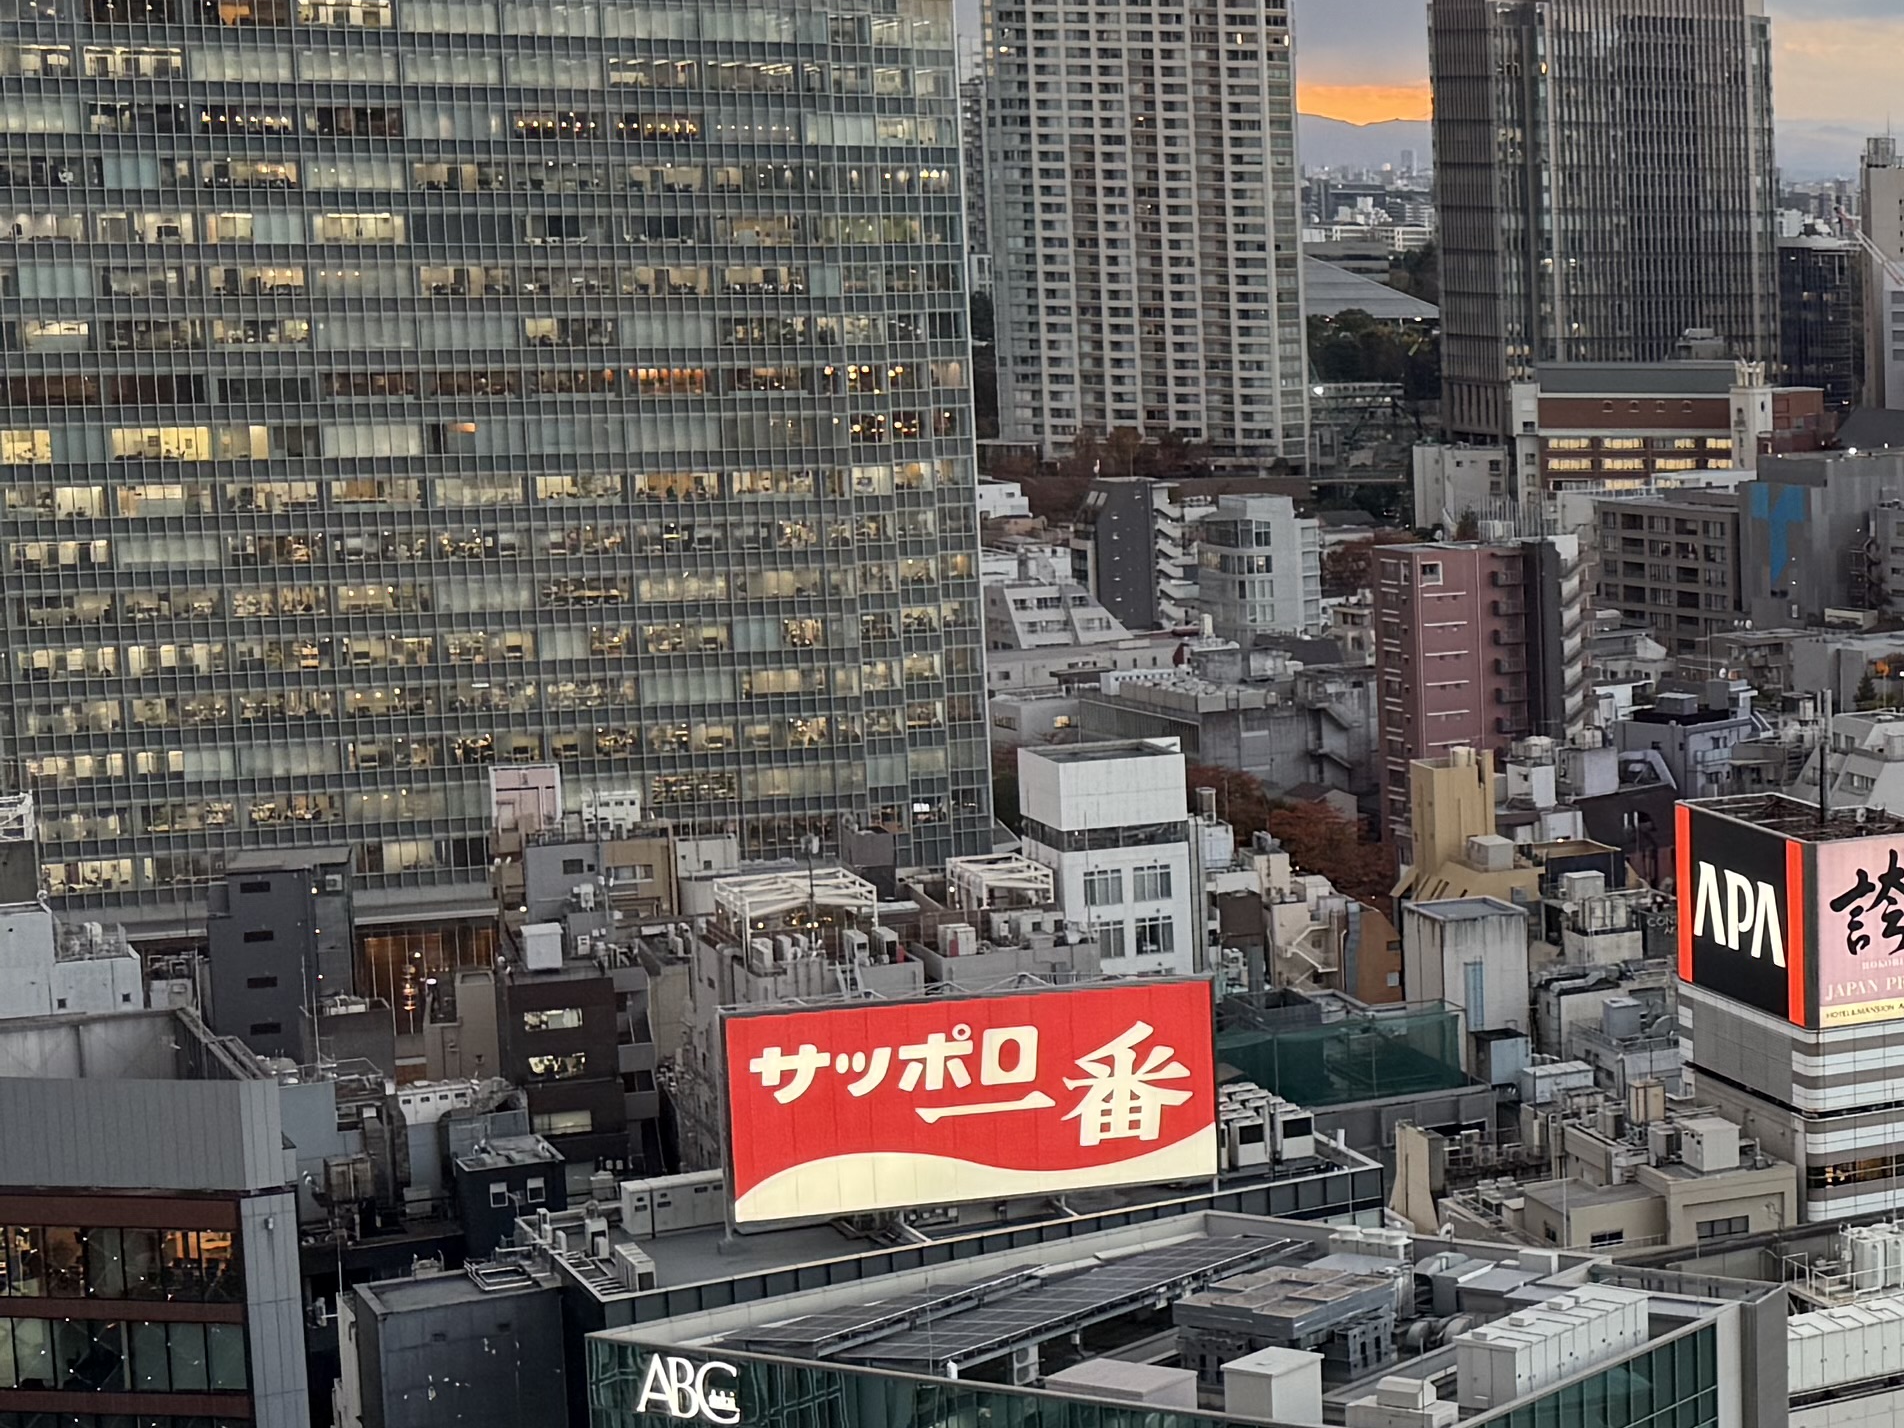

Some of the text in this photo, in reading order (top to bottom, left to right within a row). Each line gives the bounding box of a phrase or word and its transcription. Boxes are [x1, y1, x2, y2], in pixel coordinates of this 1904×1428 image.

[1693, 861, 1786, 968] APA
[1825, 979, 1879, 1002] JAPAN
[748, 1020, 1195, 1148] サッポロ一番
[636, 1352, 741, 1425] ABC
